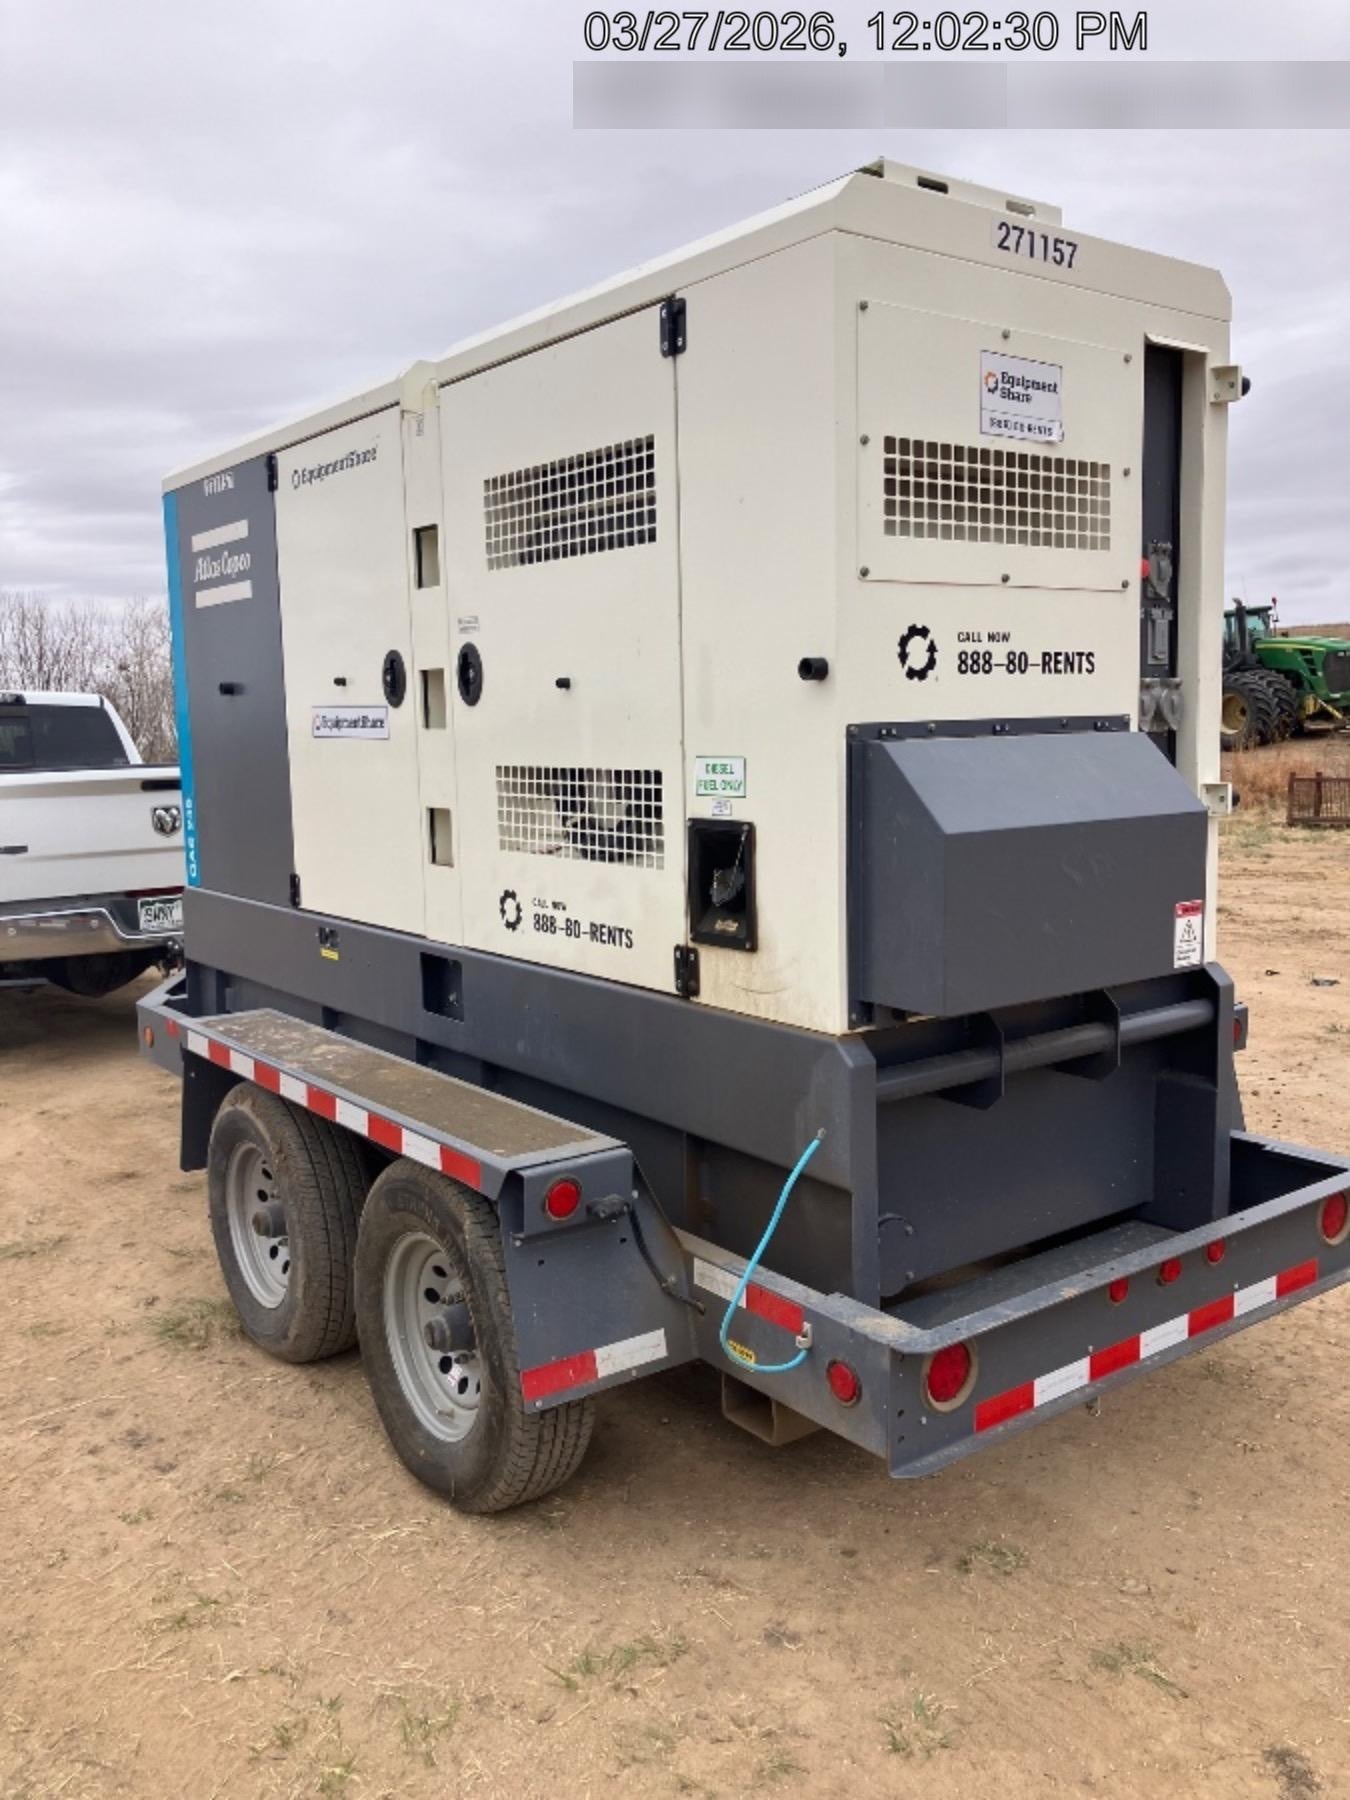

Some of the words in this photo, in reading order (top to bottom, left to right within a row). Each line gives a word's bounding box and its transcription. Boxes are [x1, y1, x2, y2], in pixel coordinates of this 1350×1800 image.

[997, 221, 1078, 269] 271157
[1001, 371, 1058, 394] Equipment
[1000, 387, 1032, 404] Share
[957, 631, 983, 643] CALL
[987, 631, 1011, 643] NOW
[957, 650, 1095, 675] 888-80-RENTS
[705, 763, 734, 775] DIESEL
[533, 913, 634, 950] 888-80-RENTS
